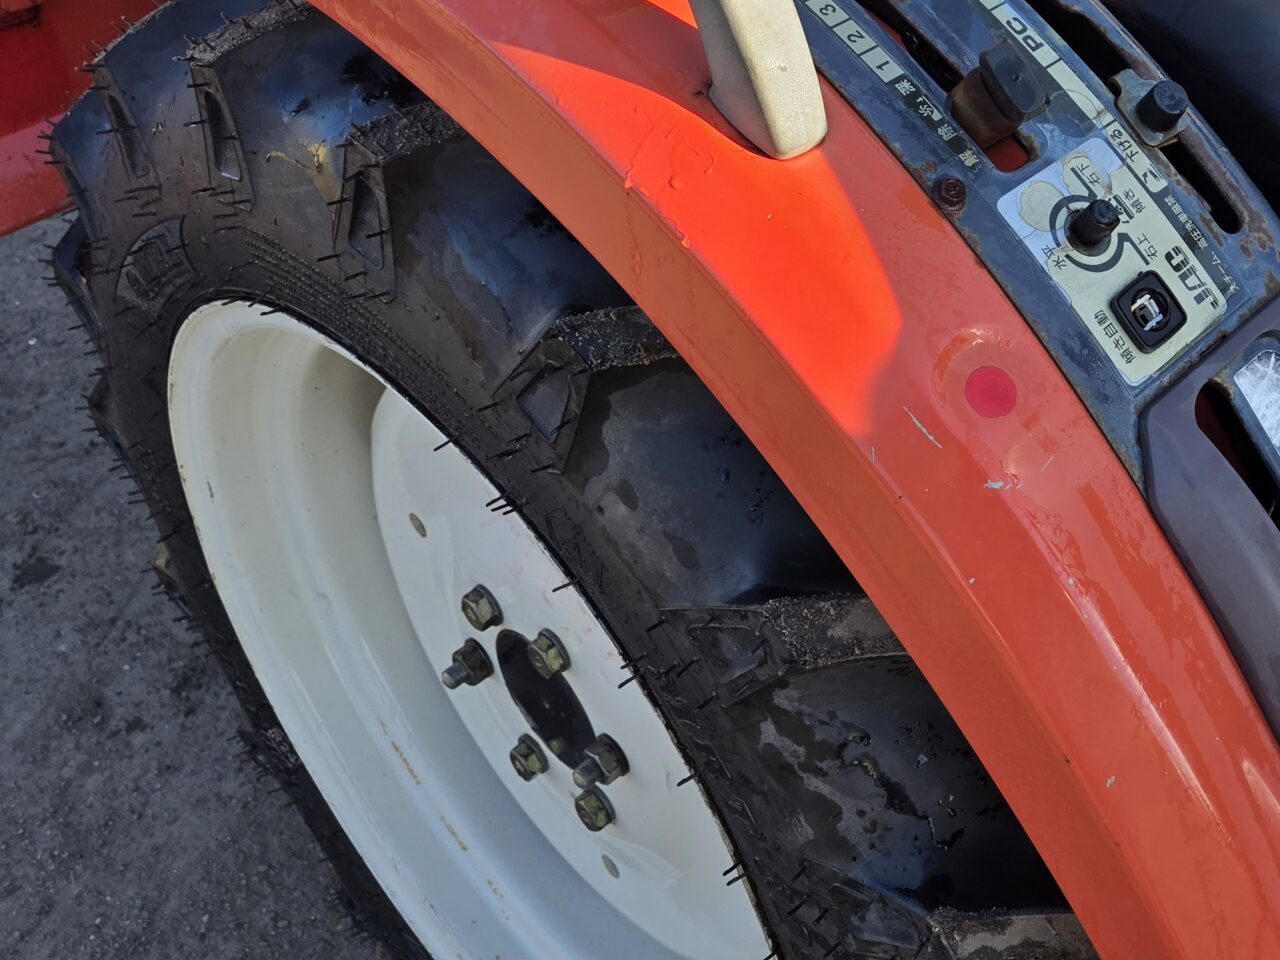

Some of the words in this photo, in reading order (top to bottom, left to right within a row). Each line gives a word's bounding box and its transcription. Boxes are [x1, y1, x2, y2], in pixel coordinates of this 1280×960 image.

[819, 4, 836, 16] 3
[846, 30, 865, 43] 2
[1006, 16, 1045, 52] PC
[876, 60, 890, 71] 1
[1111, 128, 1139, 163] 下げる
[1076, 162, 1101, 186] 右下
[1123, 188, 1146, 214] 傾き
[1041, 244, 1068, 271] 水平
[1137, 232, 1158, 260] 右上
[1094, 309, 1136, 365] 傾き自動
